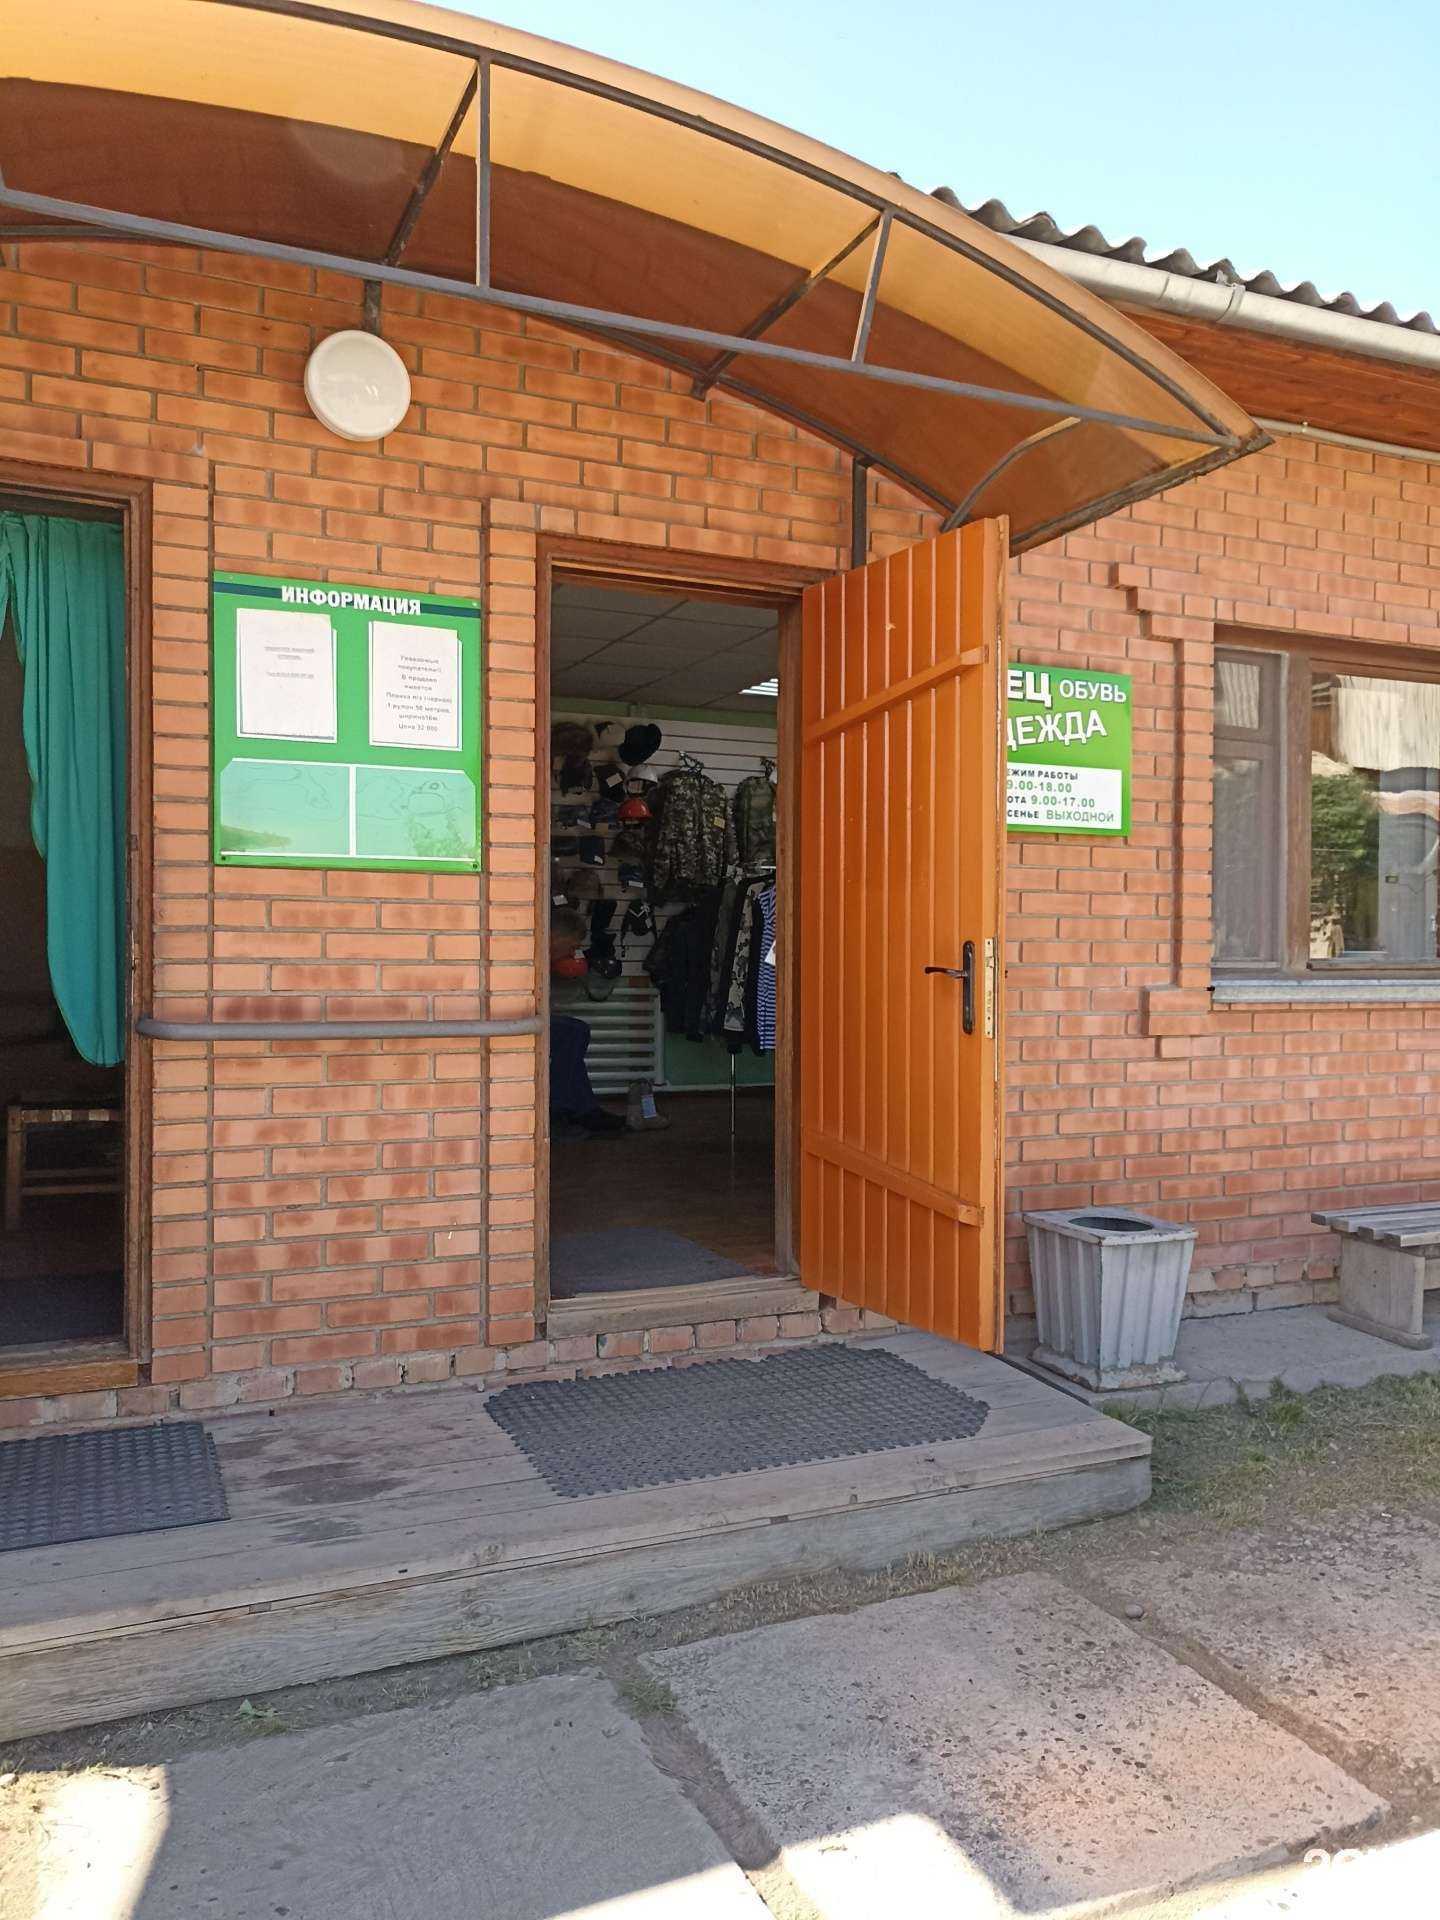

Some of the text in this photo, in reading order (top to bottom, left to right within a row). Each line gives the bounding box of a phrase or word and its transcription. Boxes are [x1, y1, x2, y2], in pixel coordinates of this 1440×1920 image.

[281, 585, 421, 616] ИНФОРМАЦИЯ
[1059, 679, 1127, 703] ОБУВЬ
[1038, 770, 1079, 780] РАБОТЫ
[1007, 779, 1072, 793] 9.00-18.00
[1031, 795, 1095, 808] 9.00-17.00
[1046, 810, 1114, 823] ВЫХОДНОЙ
